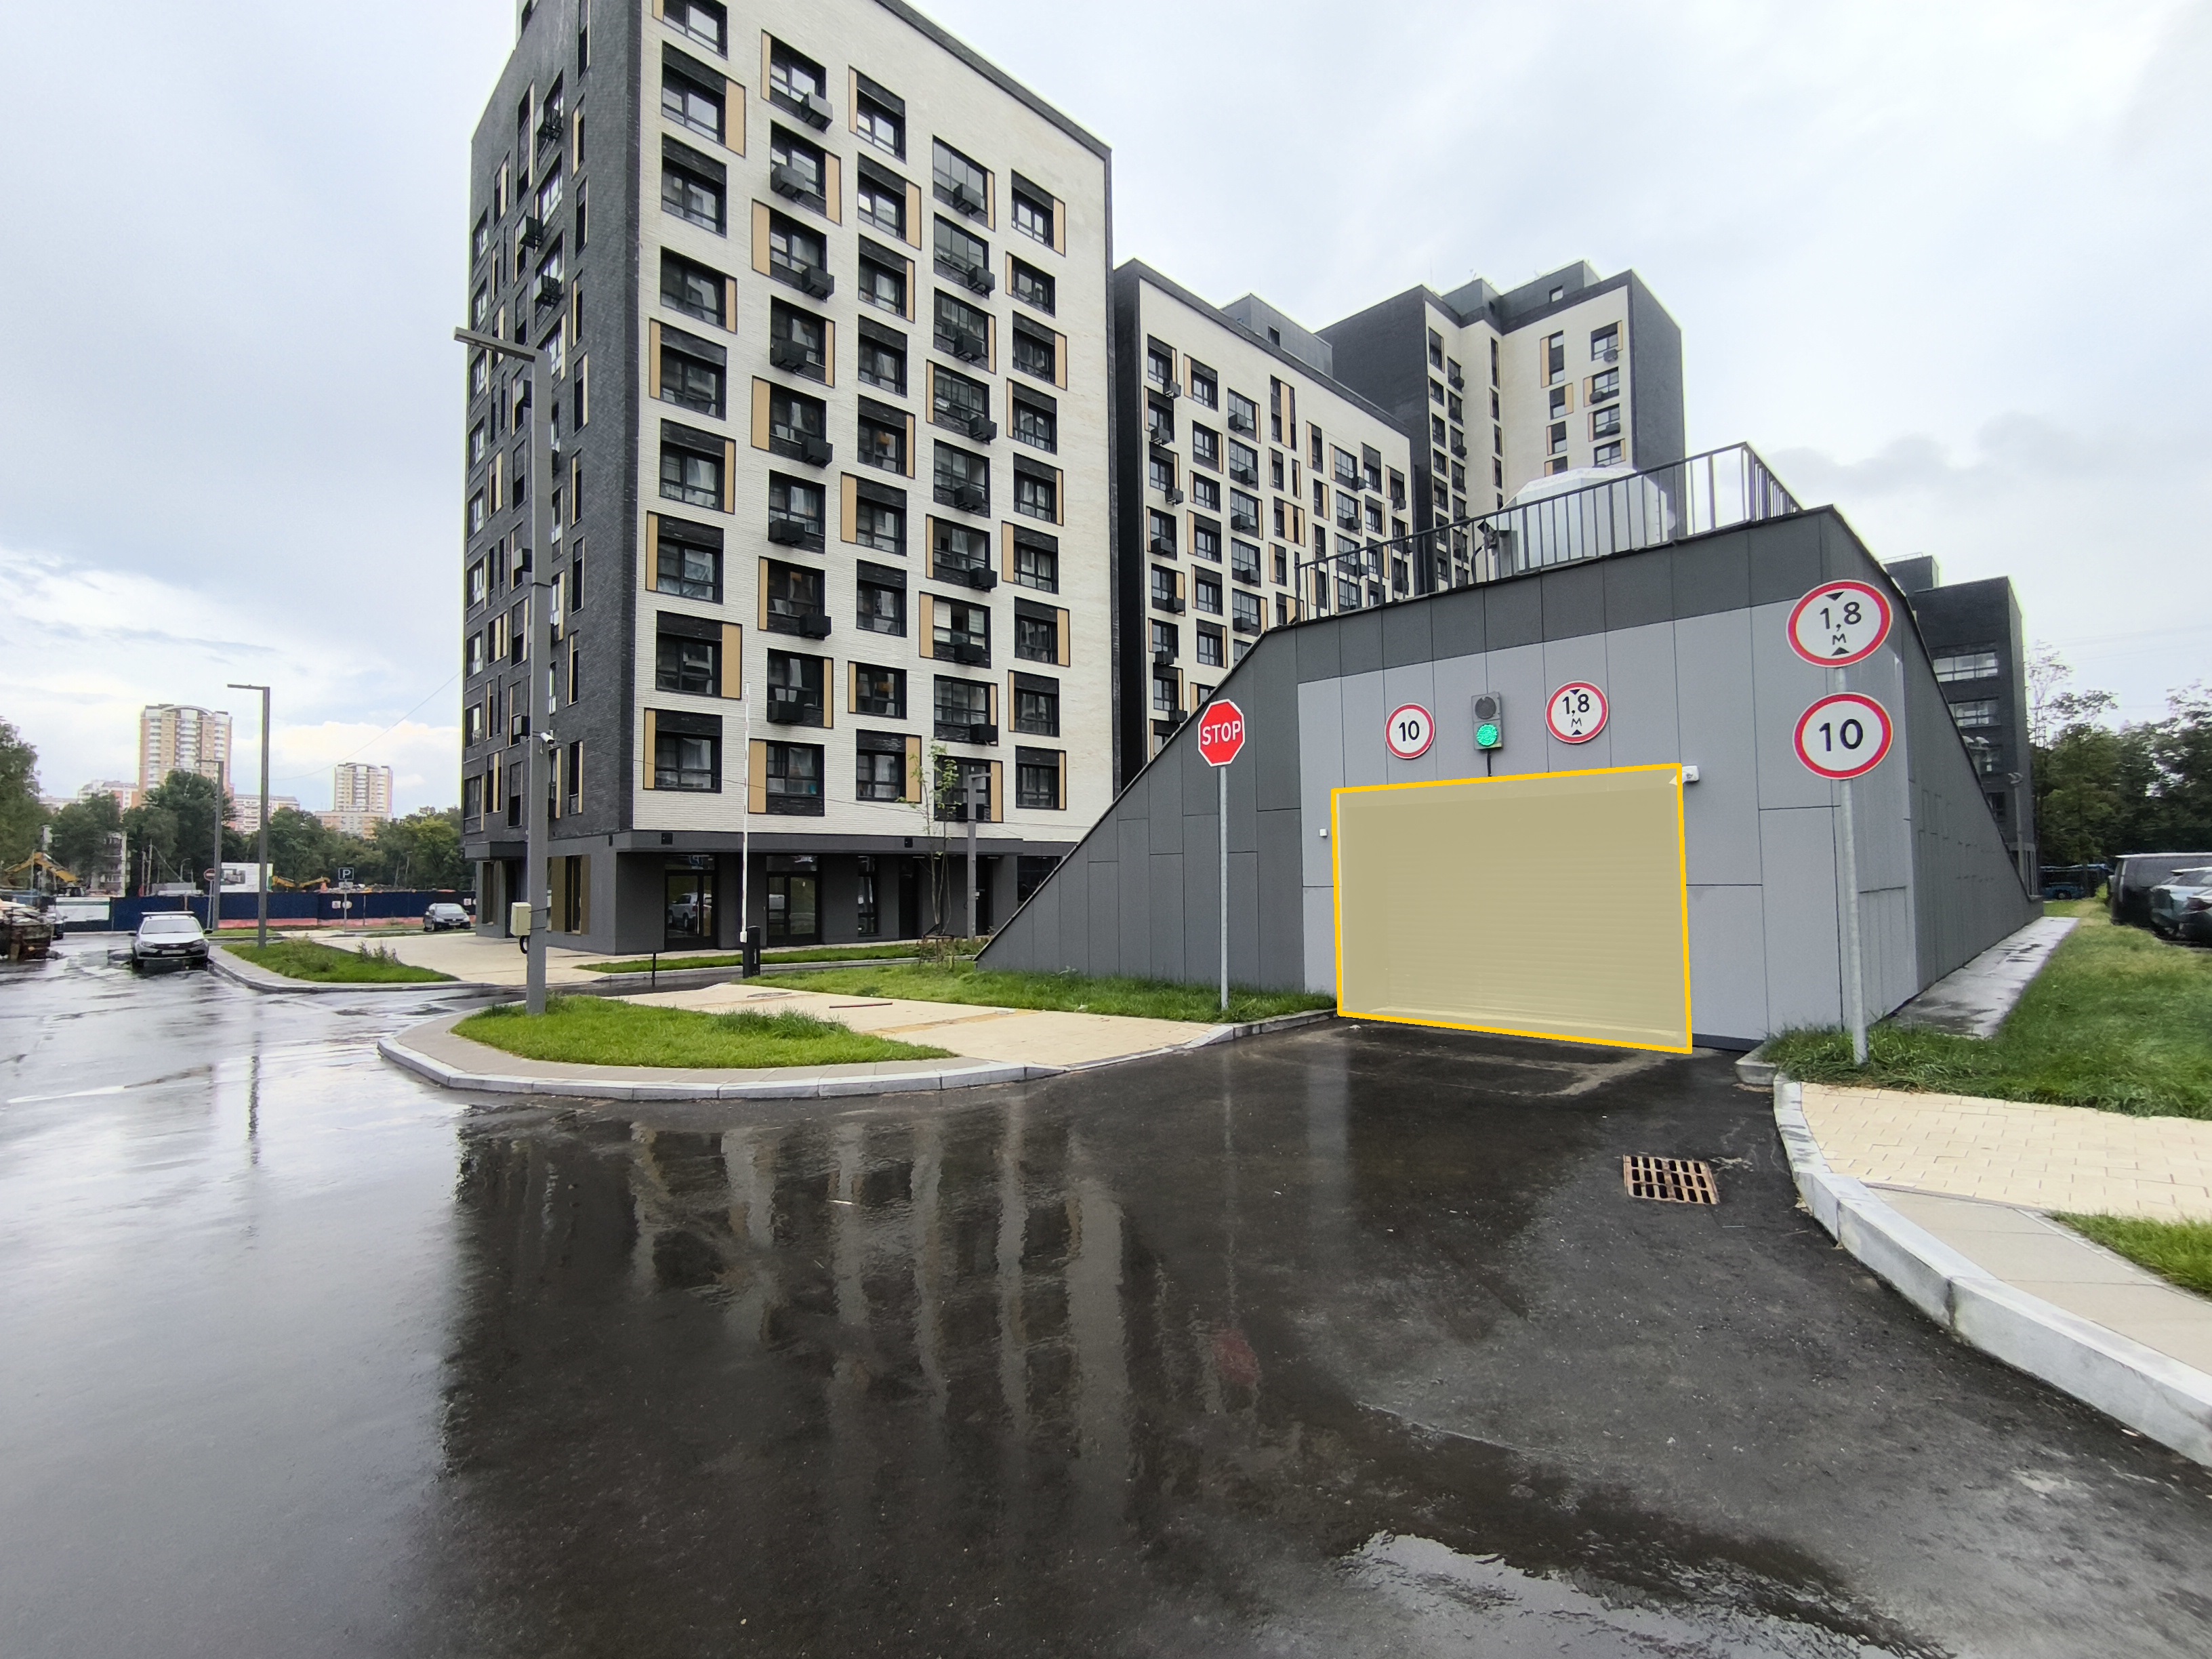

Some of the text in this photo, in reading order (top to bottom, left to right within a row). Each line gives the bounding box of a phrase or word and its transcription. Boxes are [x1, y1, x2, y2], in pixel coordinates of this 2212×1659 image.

[1820, 601, 1862, 632] 1,8
[1562, 693, 1590, 717] 1,8
[1202, 720, 1242, 745] STOP
[1399, 720, 1420, 742] 10
[1819, 718, 1864, 752] 10
[342, 869, 351, 878] P
